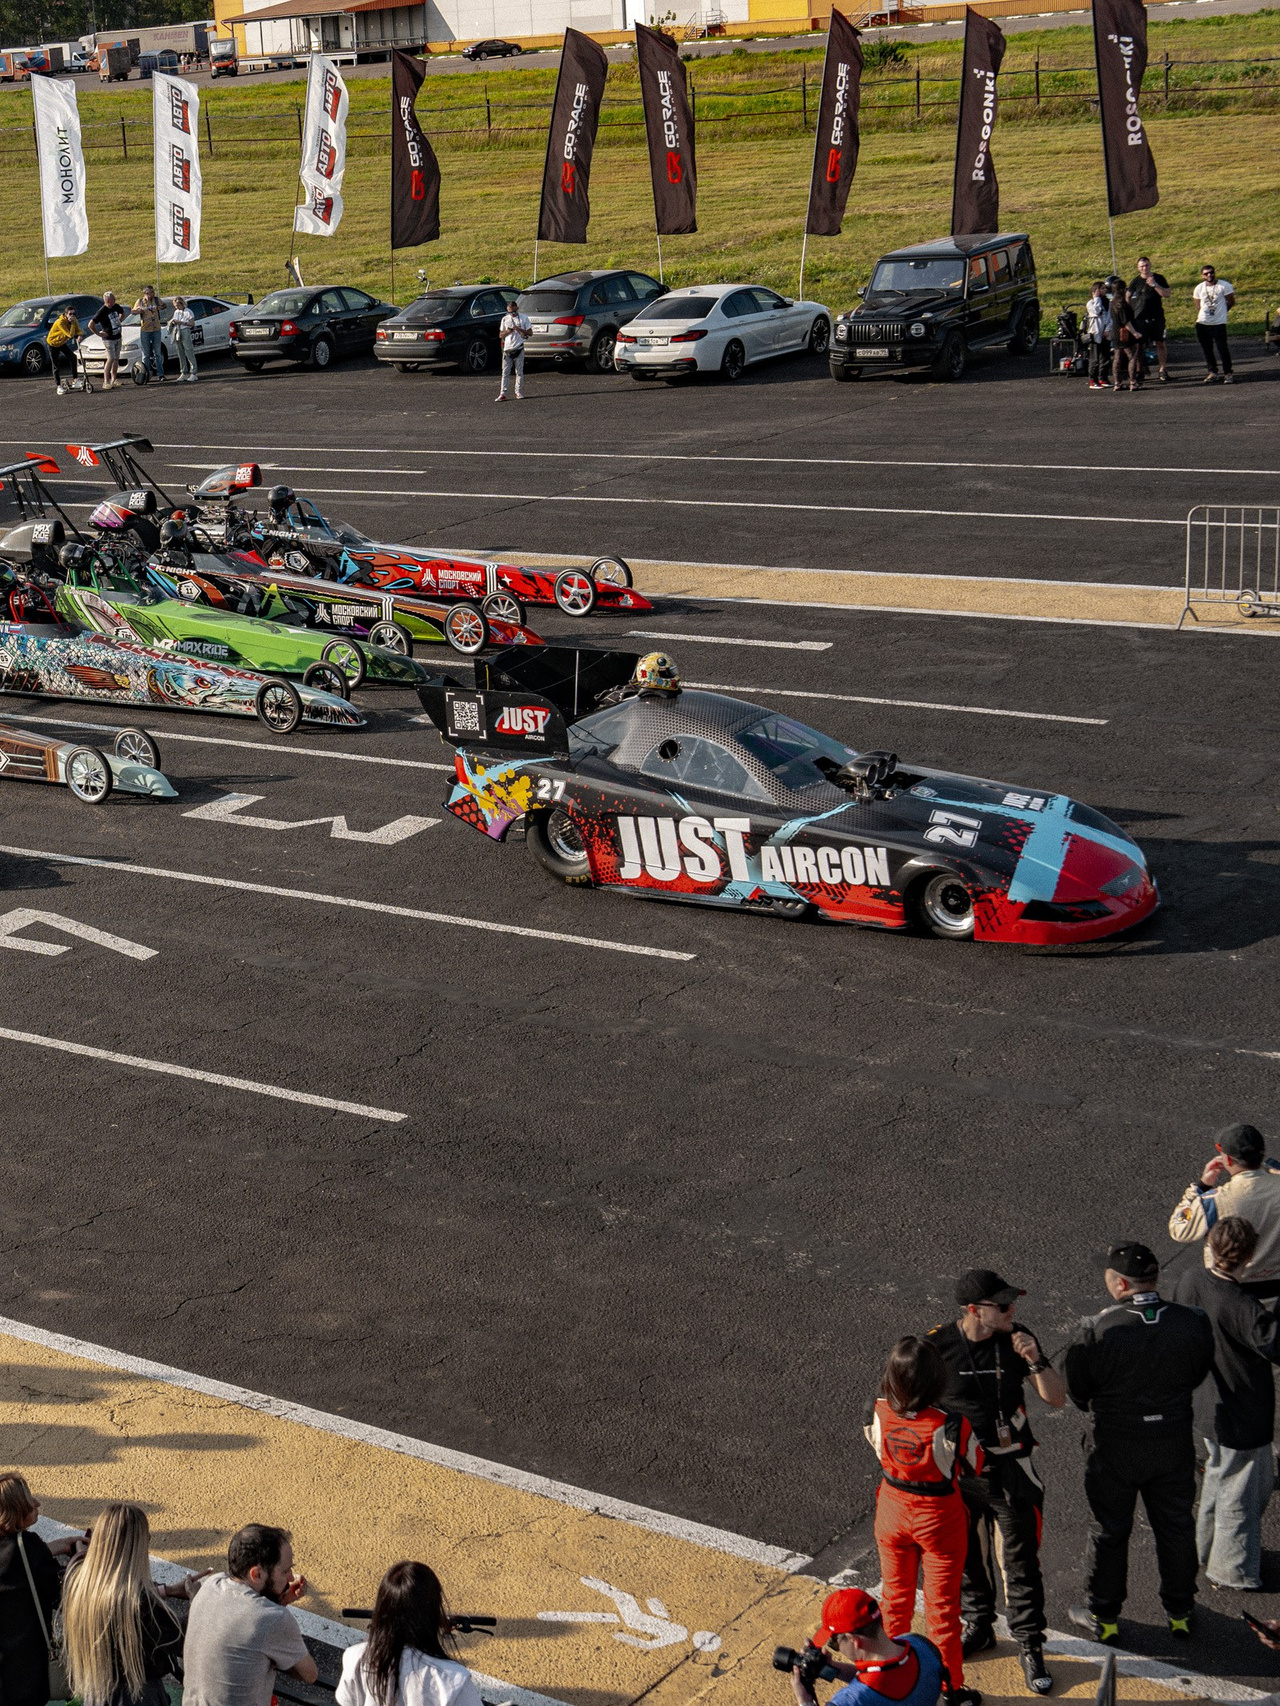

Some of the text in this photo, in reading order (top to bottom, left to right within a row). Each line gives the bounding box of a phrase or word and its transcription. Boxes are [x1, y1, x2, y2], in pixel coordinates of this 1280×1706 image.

[170, 88, 183, 128] АВТО
[324, 74, 336, 113] АВТО
[972, 71, 995, 182] ROSGONKI
[60, 126, 75, 204] МОНОЛИТ
[173, 147, 183, 188] АВТО
[317, 133, 331, 174] АВТО
[173, 206, 183, 245] АВТО
[438, 569, 482, 582] МОСКОВСКИЙ
[438, 579, 460, 590] СПОРТ
[331, 603, 379, 618] МОСКОВСКИЙ
[332, 614, 355, 627] СПОРТ
[502, 706, 546, 734] JUST
[524, 733, 545, 742] AIRCON
[537, 778, 566, 801] 27
[181, 792, 442, 845] 3
[923, 809, 982, 848] 27
[617, 815, 891, 886] JUST AIRCON
